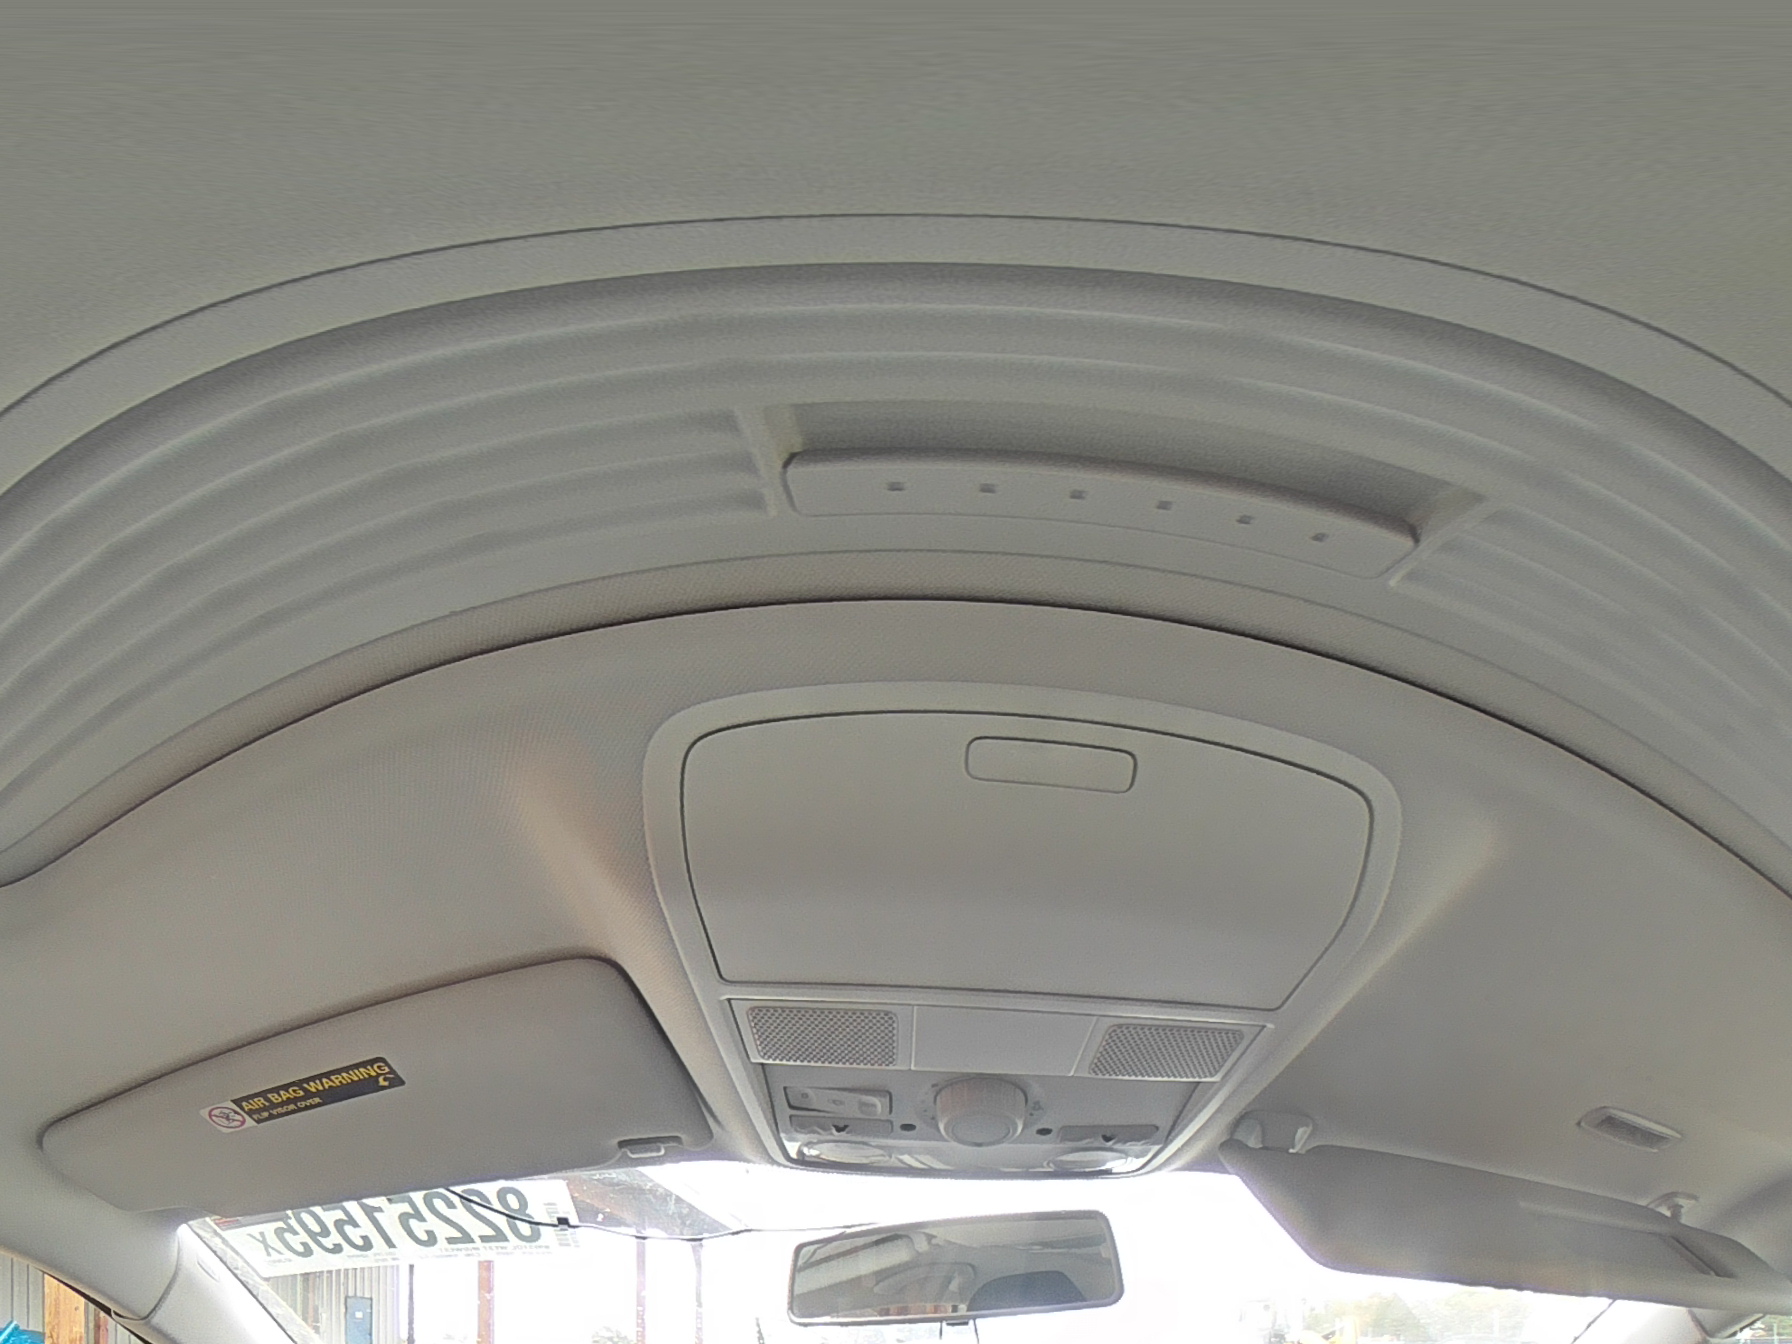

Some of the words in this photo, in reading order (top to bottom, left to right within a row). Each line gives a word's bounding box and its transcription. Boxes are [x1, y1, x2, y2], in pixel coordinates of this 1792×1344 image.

[241, 1098, 270, 1112] AIR
[267, 1086, 304, 1104] BAG
[302, 1062, 390, 1093] WARNING
[252, 1112, 270, 1120] FLIP
[270, 1104, 298, 1116] VISOR
[297, 1096, 323, 1109] OVER
